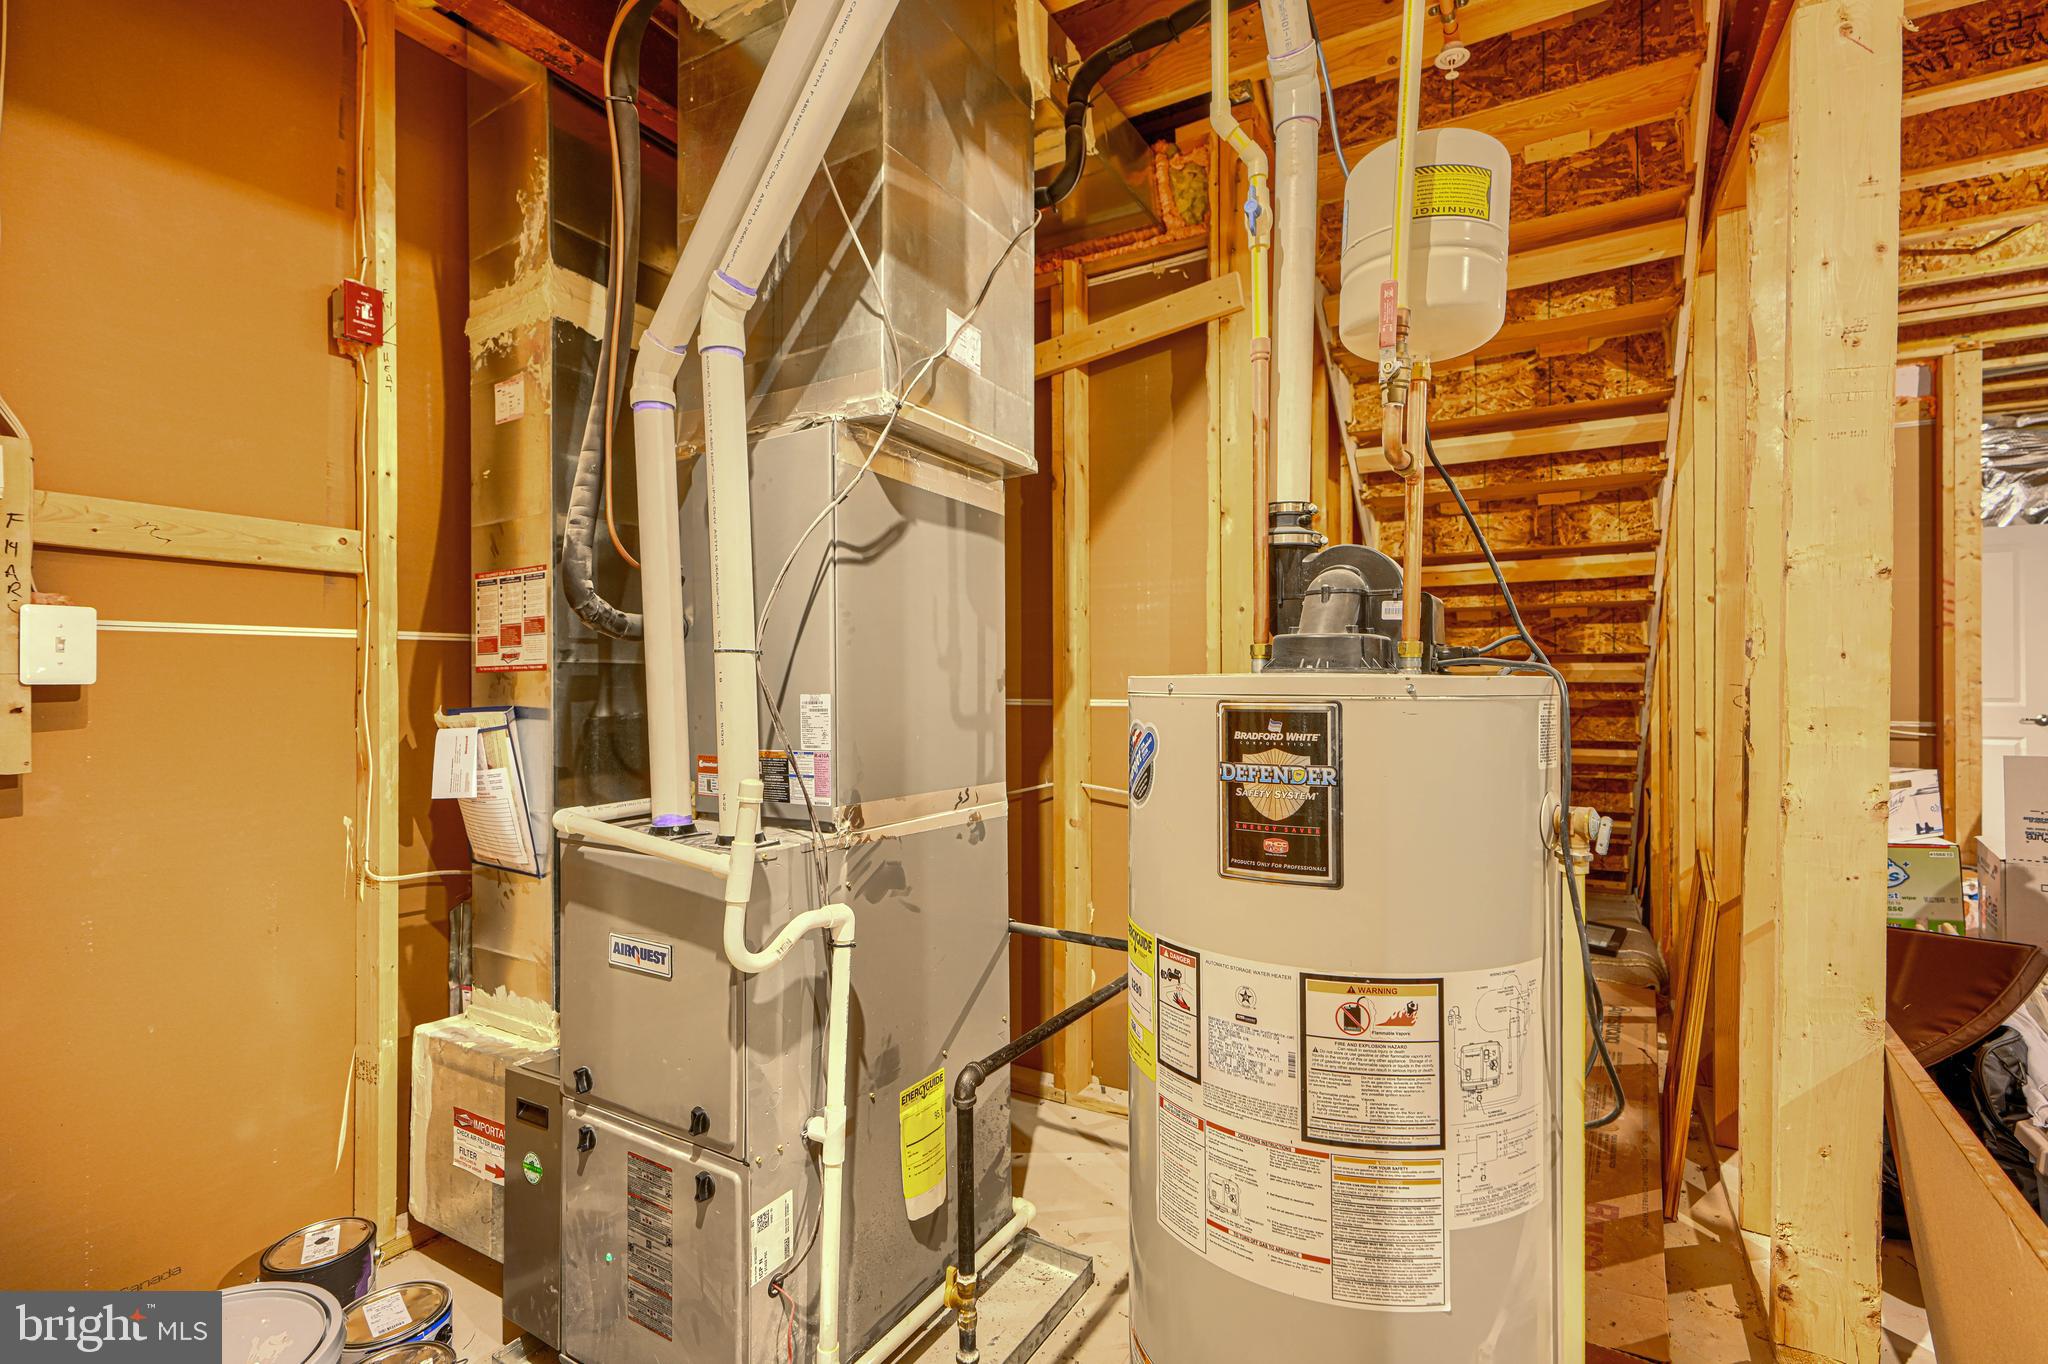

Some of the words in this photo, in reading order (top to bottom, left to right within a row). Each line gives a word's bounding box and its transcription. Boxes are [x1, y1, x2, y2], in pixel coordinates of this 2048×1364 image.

[1415, 205, 1486, 217] WARNING!
[1234, 731, 1283, 741] BRADFORD
[1286, 732, 1320, 742] WHITE
[1221, 764, 1336, 787] DEFENDER
[1235, 787, 1271, 798] SAFETY
[1274, 790, 1319, 801] SYSTEM
[613, 942, 667, 966] AIRQUEST
[1169, 951, 1191, 966] DANGER
[1358, 986, 1398, 995] WARNING
[901, 1072, 944, 1107] ENERGYGUIDE
[456, 1129, 469, 1138] CHECK
[473, 1119, 506, 1139] IMPORTA
[459, 1146, 478, 1160] FILTER
